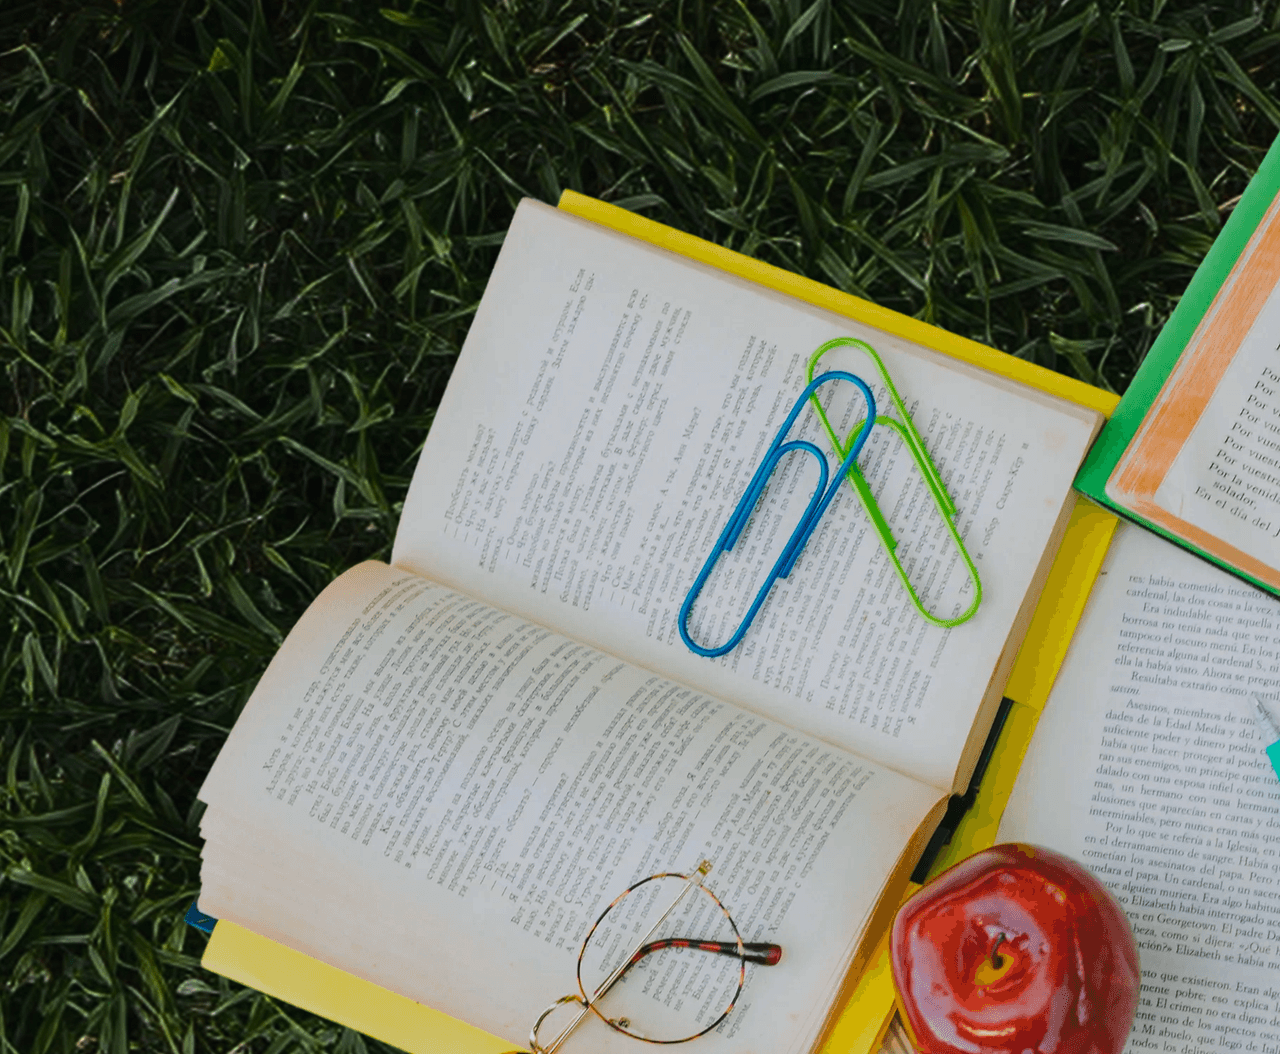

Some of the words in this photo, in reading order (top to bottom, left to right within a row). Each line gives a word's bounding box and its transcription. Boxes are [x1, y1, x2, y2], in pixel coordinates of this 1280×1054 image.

[1254, 380, 1275, 396] Por
[1246, 394, 1266, 410] Por
[1239, 407, 1260, 423] Por
[1223, 435, 1243, 451] Por
[1194, 485, 1212, 501] En
[1215, 499, 1227, 509] el
[1229, 506, 1248, 521] día
[1251, 517, 1271, 531] del
[262, 748, 280, 771] Хоть
[293, 707, 303, 719] не
[303, 681, 321, 702] стар,
